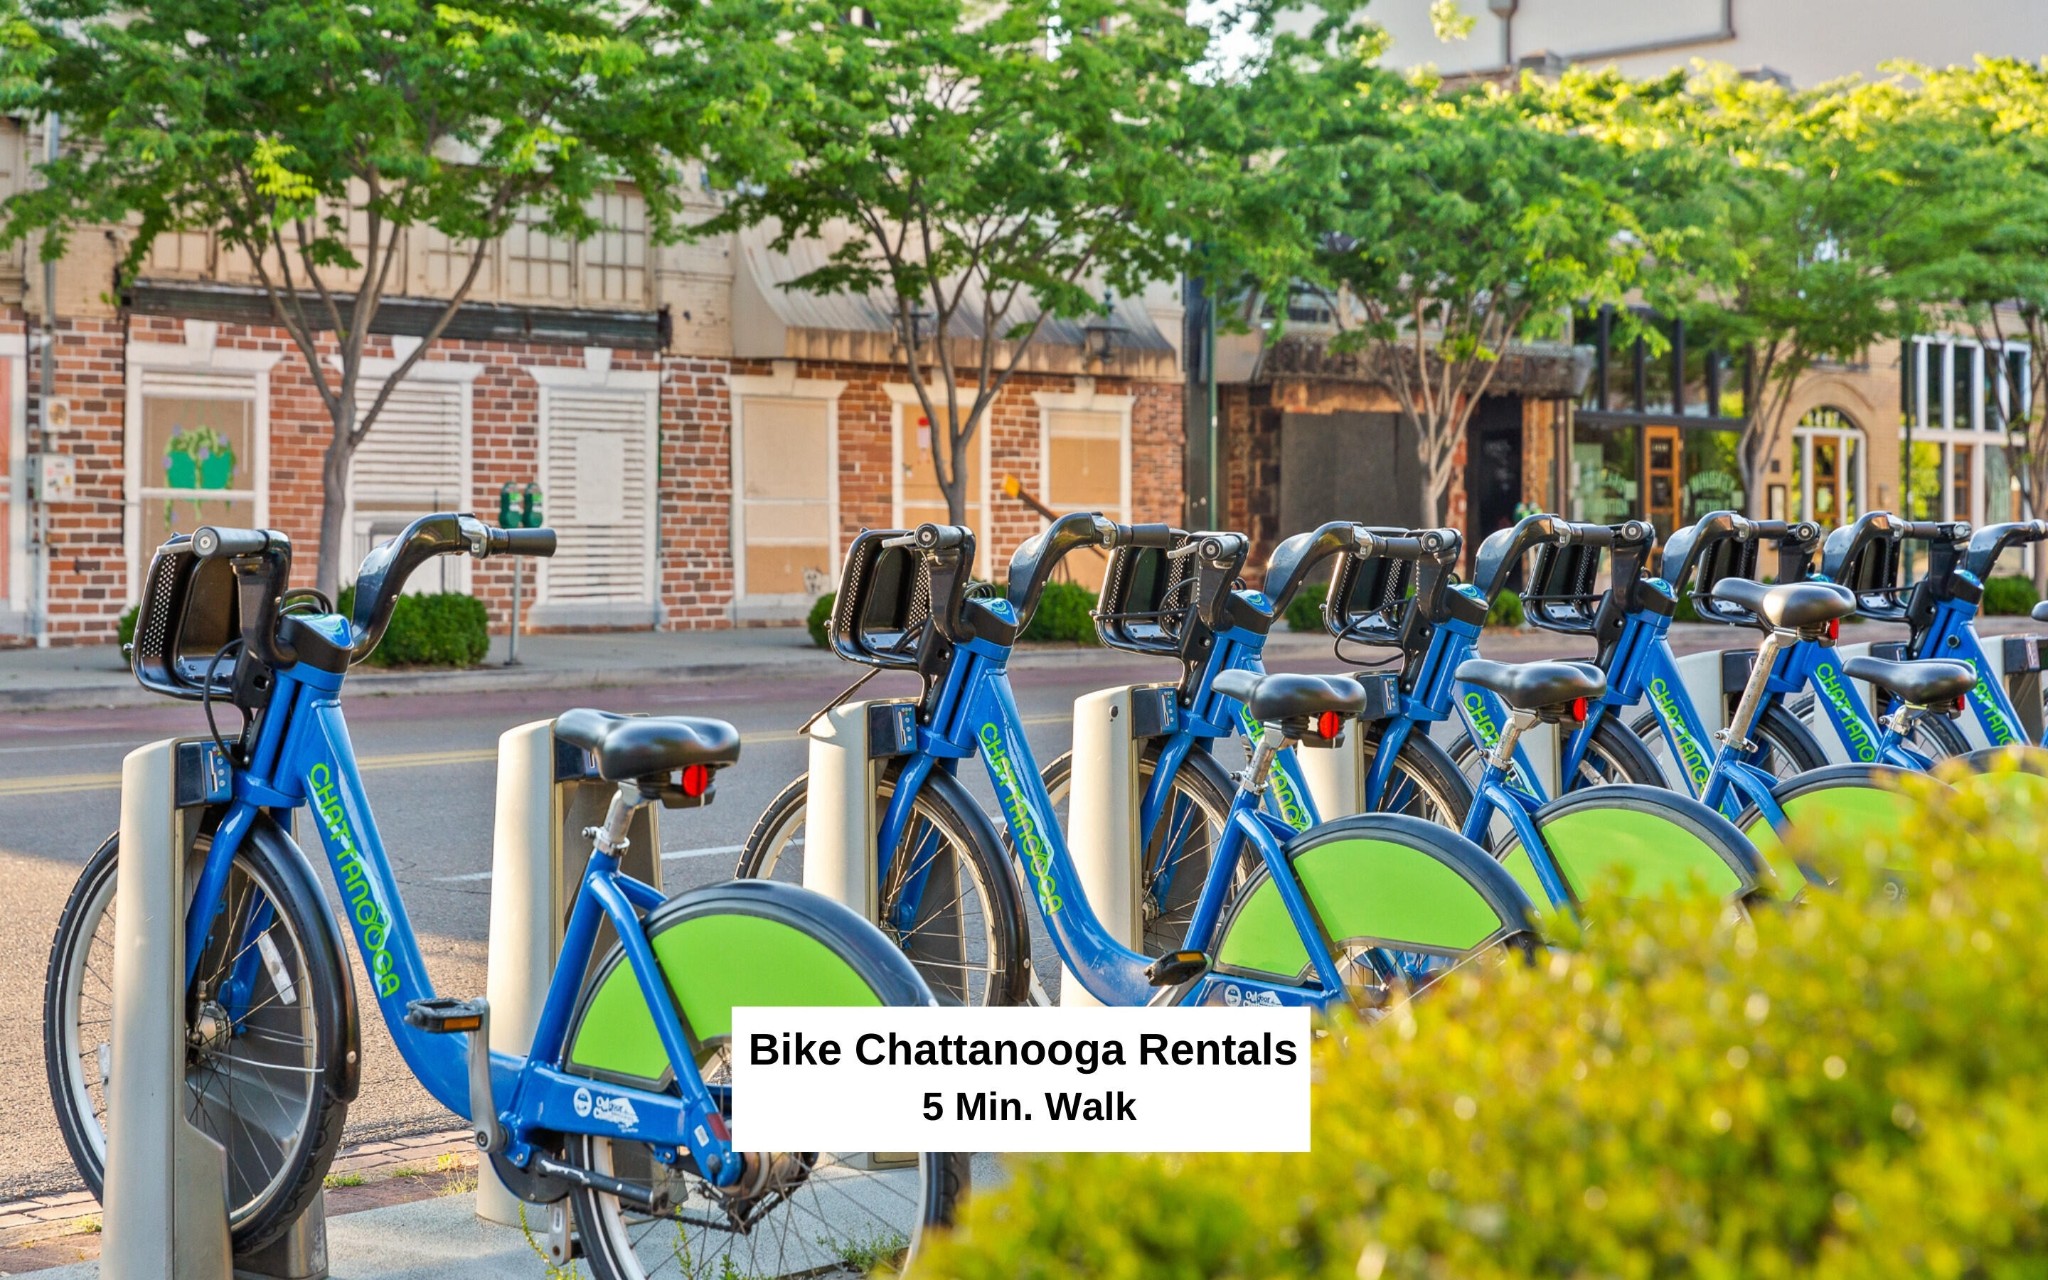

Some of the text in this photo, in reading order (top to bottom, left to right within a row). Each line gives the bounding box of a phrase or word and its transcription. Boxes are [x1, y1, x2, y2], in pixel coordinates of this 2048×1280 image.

[1650, 678, 1709, 794] CHATTANO
[1816, 663, 1876, 762] CHATTANO
[309, 763, 401, 998] CHATTANOOGA
[980, 722, 1063, 916] CHATTANOOGA
